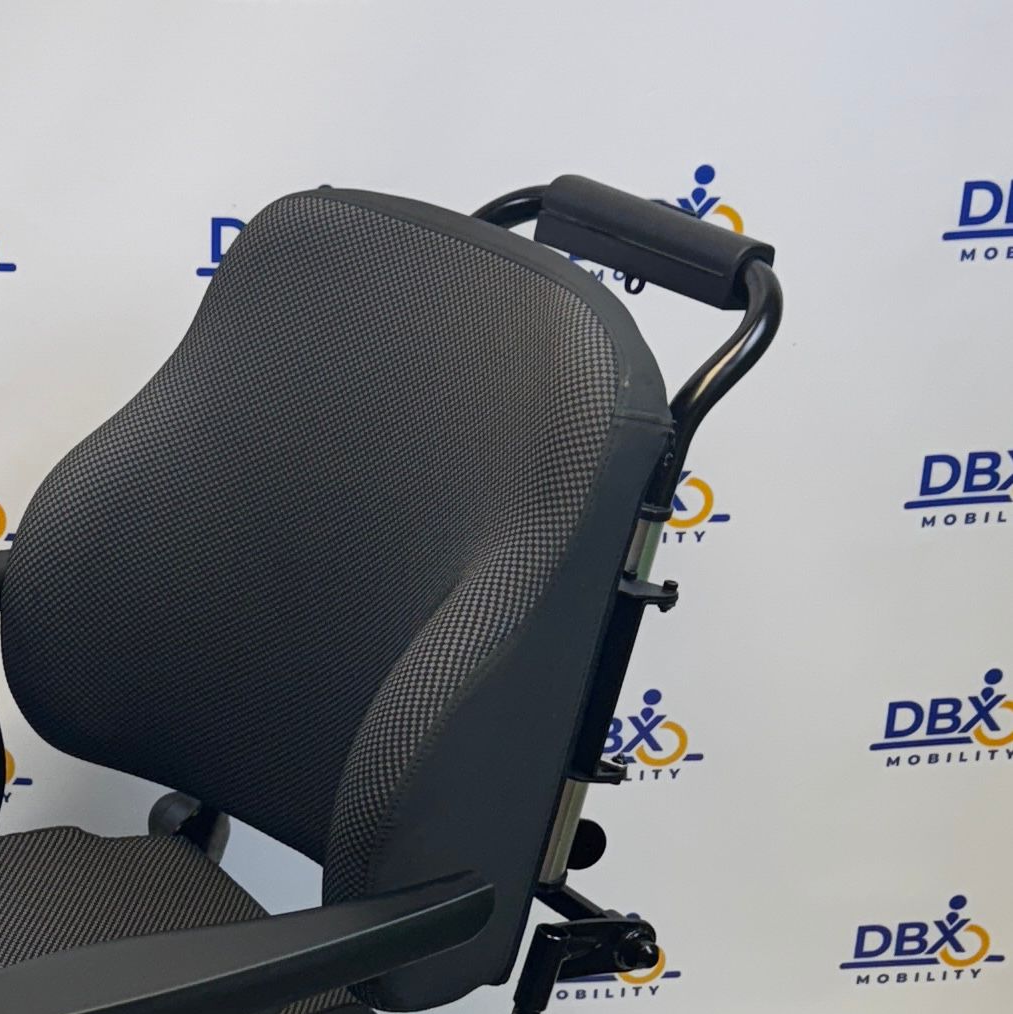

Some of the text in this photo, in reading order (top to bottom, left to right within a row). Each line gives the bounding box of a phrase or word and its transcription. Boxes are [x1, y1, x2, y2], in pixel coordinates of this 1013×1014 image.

[919, 452, 1013, 497] DB
[922, 511, 1007, 528] MOBIL
[884, 694, 1008, 740] DBX
[603, 714, 666, 753] BX
[886, 749, 1013, 767] MOBILITY
[854, 920, 971, 959] DBX
[856, 969, 981, 984] MOBILITY
[556, 985, 659, 1000] OBILITY
